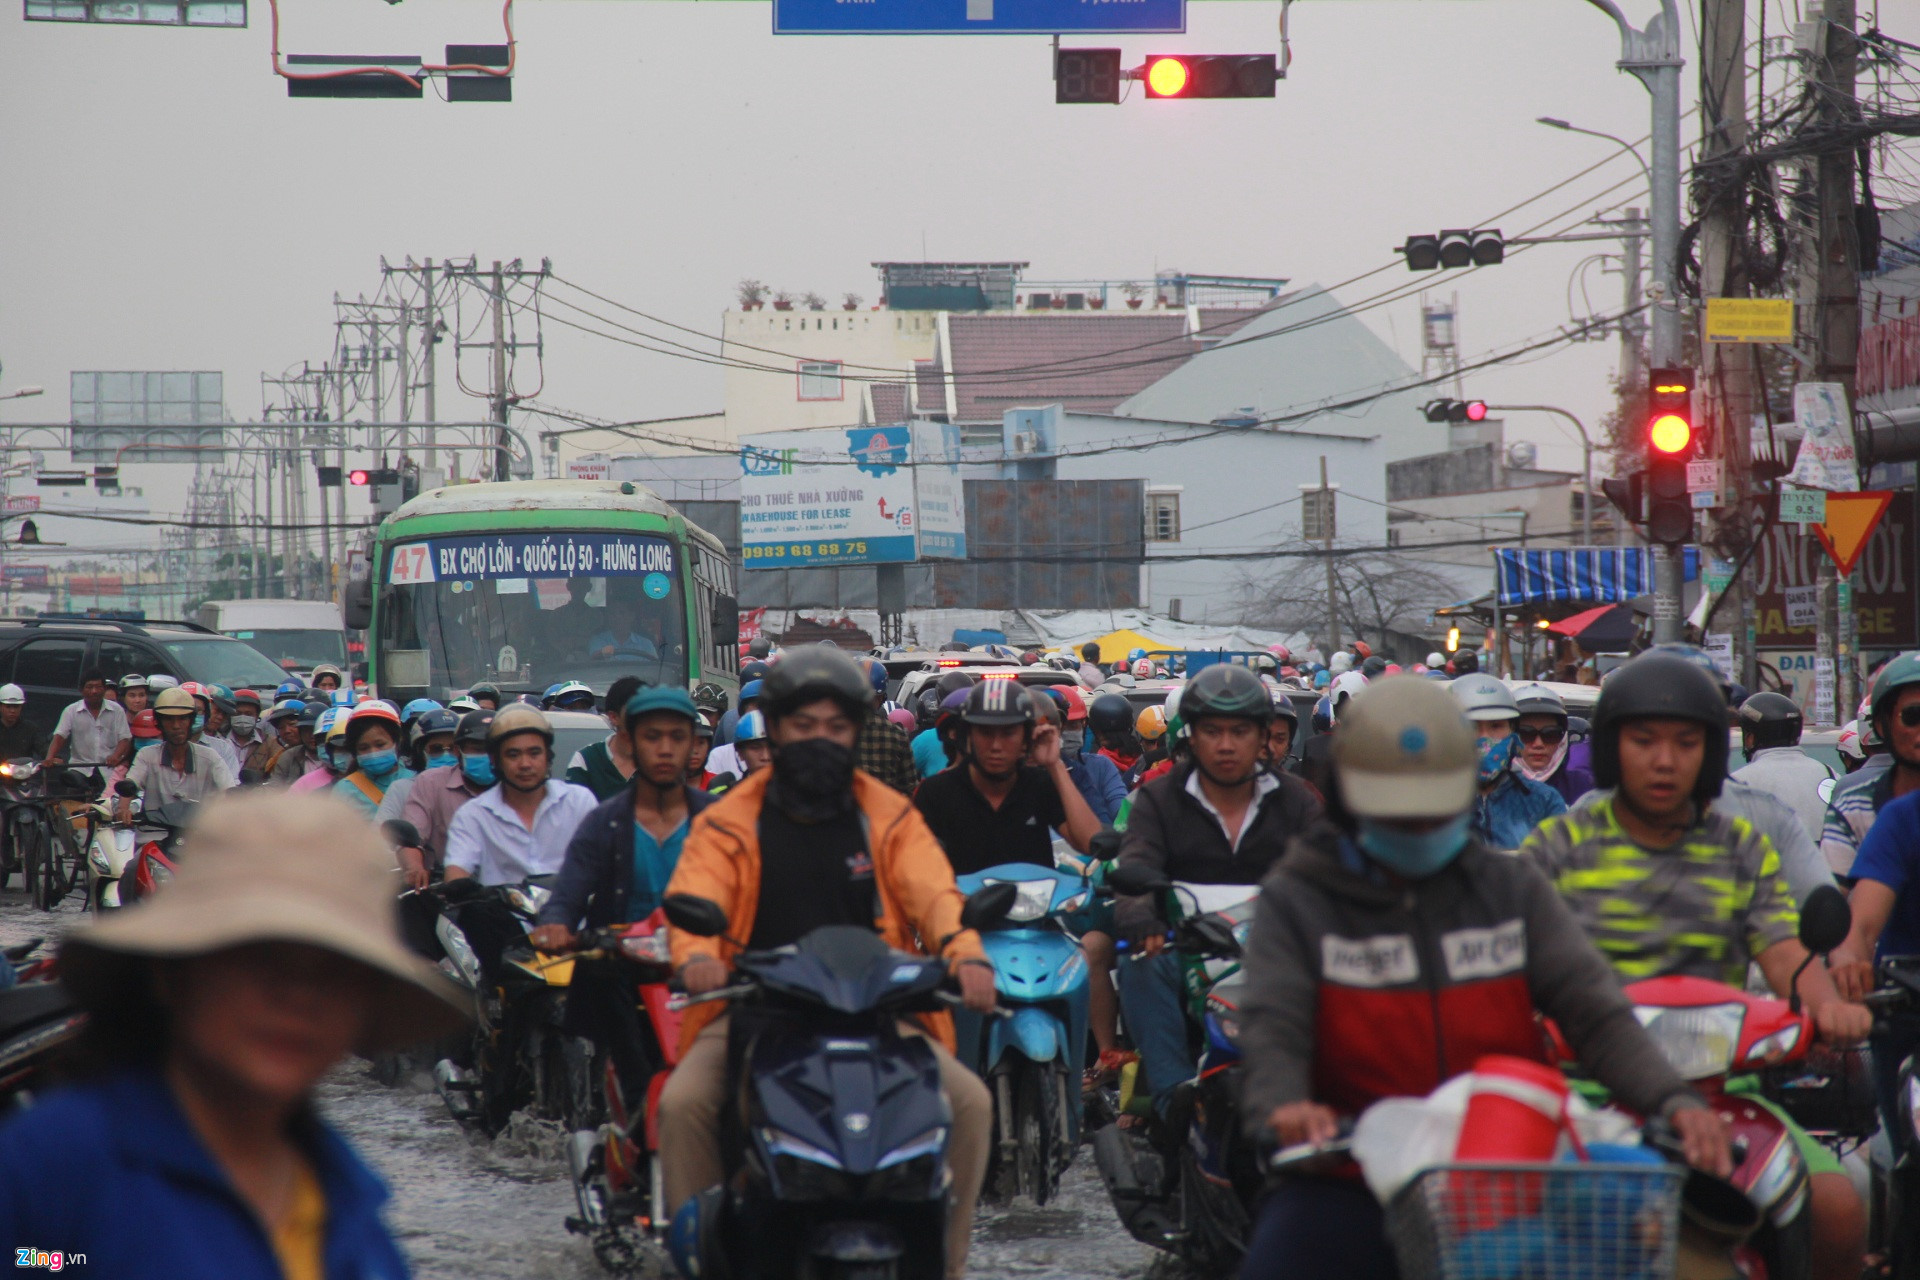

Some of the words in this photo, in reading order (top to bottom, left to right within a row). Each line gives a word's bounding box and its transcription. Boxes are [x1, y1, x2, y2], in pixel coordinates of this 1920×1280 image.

[741, 494, 761, 507] CHO
[765, 490, 794, 506] THUÊ
[798, 488, 821, 504] NHÀ
[826, 485, 864, 503] XƯỞNG
[741, 510, 798, 523] WAREHOUSE
[801, 509, 819, 520] FOR
[821, 508, 851, 519] LEASE
[440, 548, 457, 575] BX
[461, 542, 486, 580] CHỢ
[489, 538, 513, 573] LỚN
[523, 536, 557, 573] QUỐC
[560, 538, 576, 578] LỘ
[578, 544, 593, 571] 50
[640, 544, 672, 572] LONG
[742, 546, 785, 559] 0983
[845, 541, 867, 554] 75
[393, 547, 426, 580] 47
